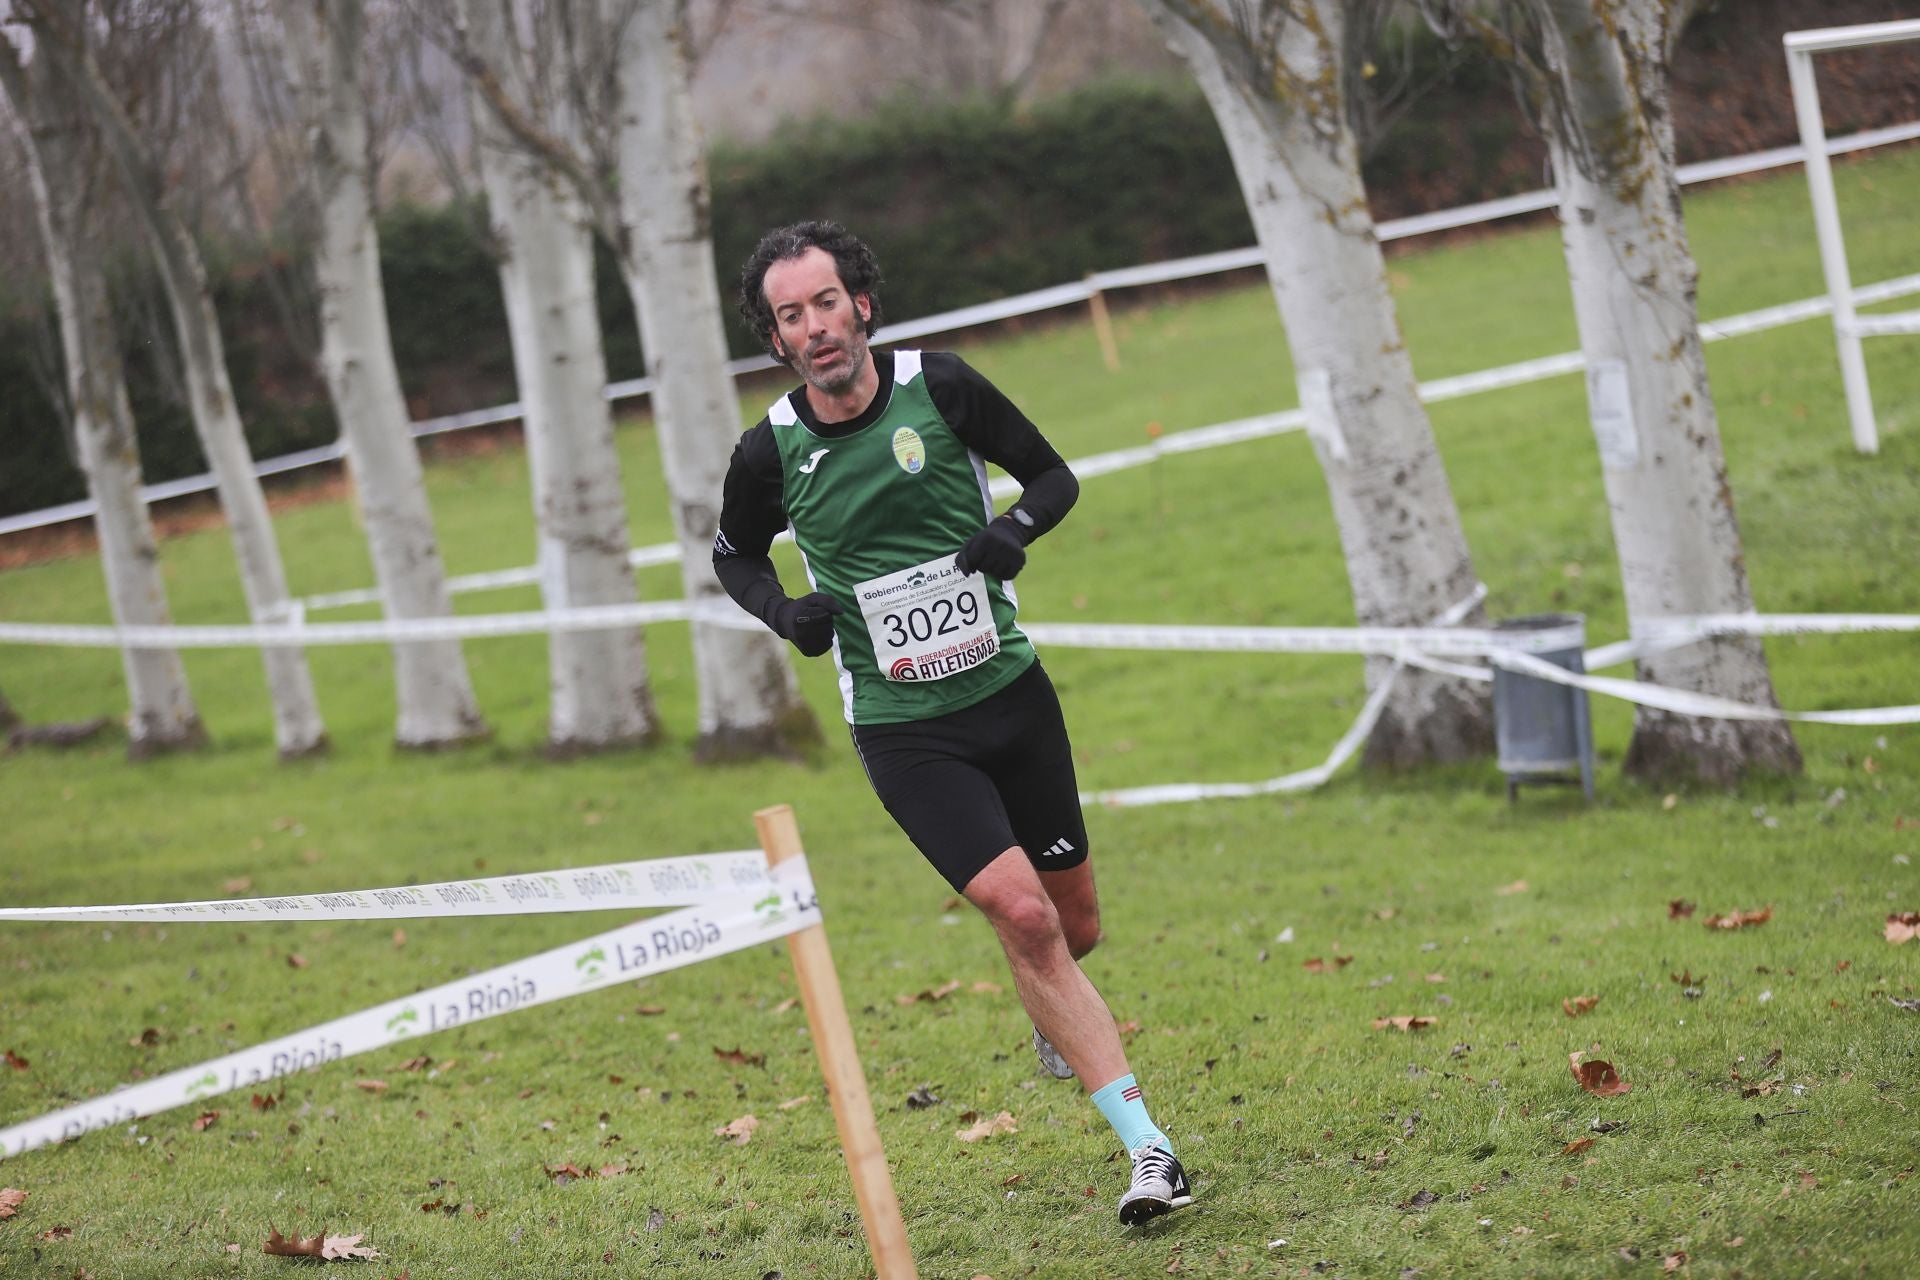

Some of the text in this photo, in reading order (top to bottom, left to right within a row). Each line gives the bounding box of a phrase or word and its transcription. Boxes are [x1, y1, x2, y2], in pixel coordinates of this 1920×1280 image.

[864, 583, 908, 600] Gobierno
[926, 573, 938, 583] de
[940, 567, 952, 577] La
[883, 591, 979, 648] 3029
[916, 630, 993, 665] FEDERACIÓN RIOJANA DE
[918, 638, 996, 680] ATLETISMO
[615, 917, 722, 973] La Rioja
[428, 974, 537, 1031] La Rioja
